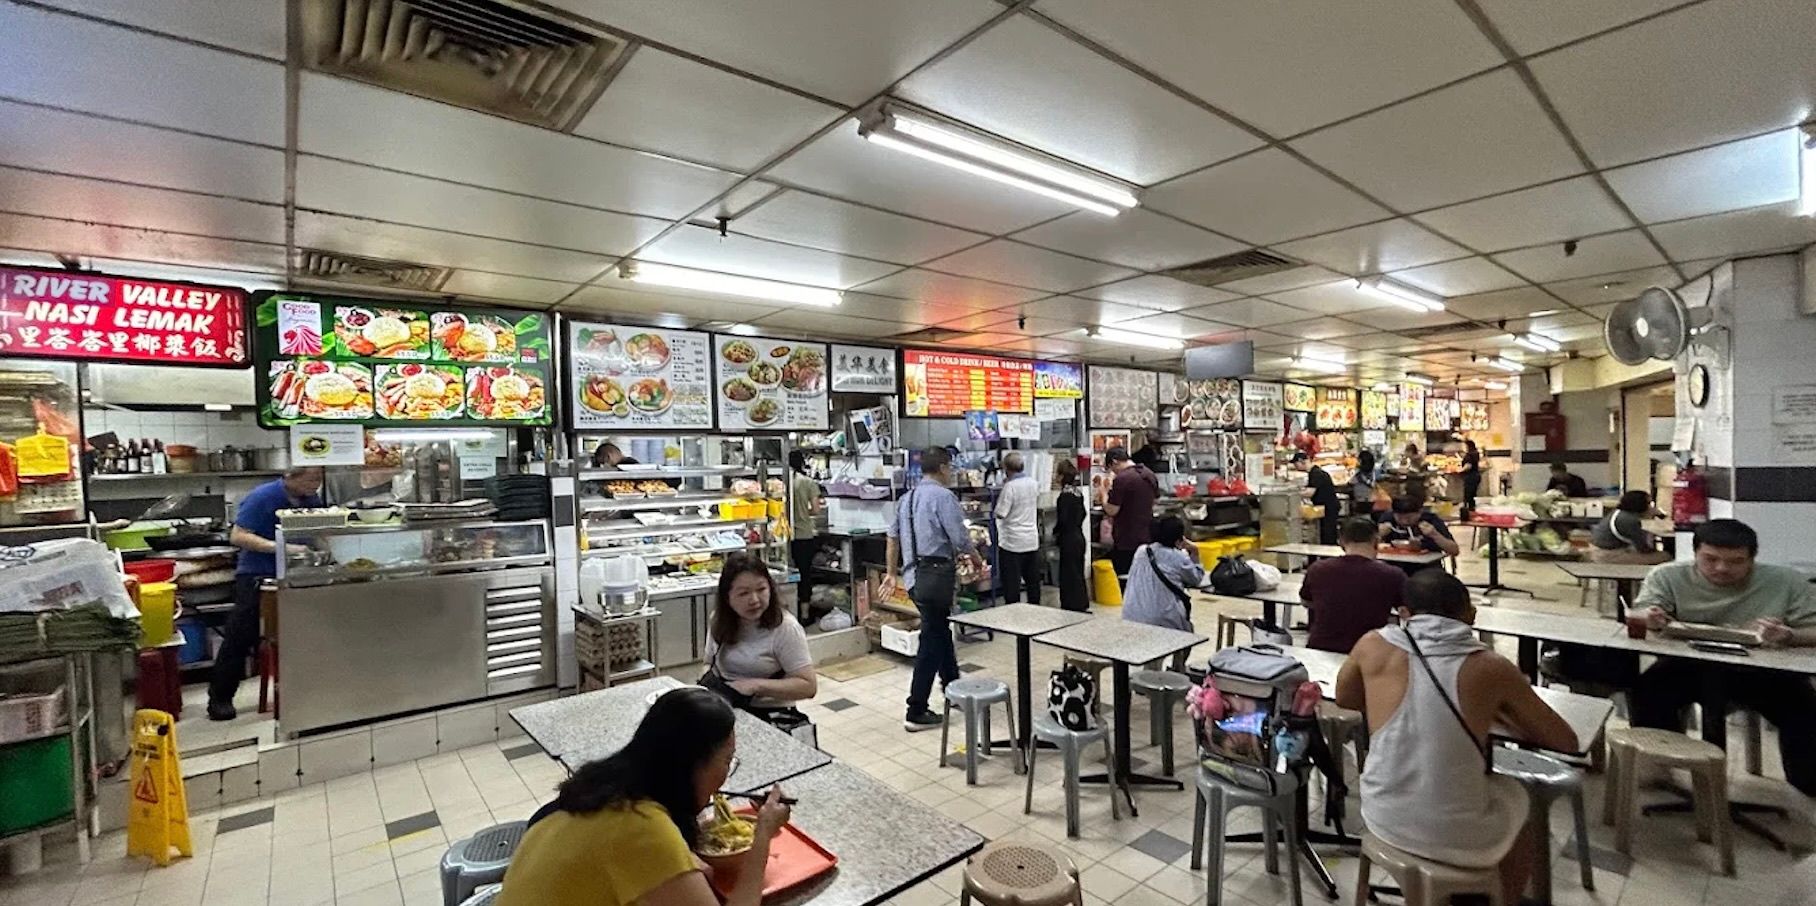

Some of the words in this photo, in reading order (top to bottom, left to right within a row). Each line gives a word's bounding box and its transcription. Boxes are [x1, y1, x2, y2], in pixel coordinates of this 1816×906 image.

[13, 274, 110, 304] RIVER
[122, 284, 222, 311] VALLEY
[24, 300, 101, 326] NASI
[113, 307, 215, 335] LEMAK
[919, 354, 933, 363] HOT
[941, 356, 960, 365] COLD
